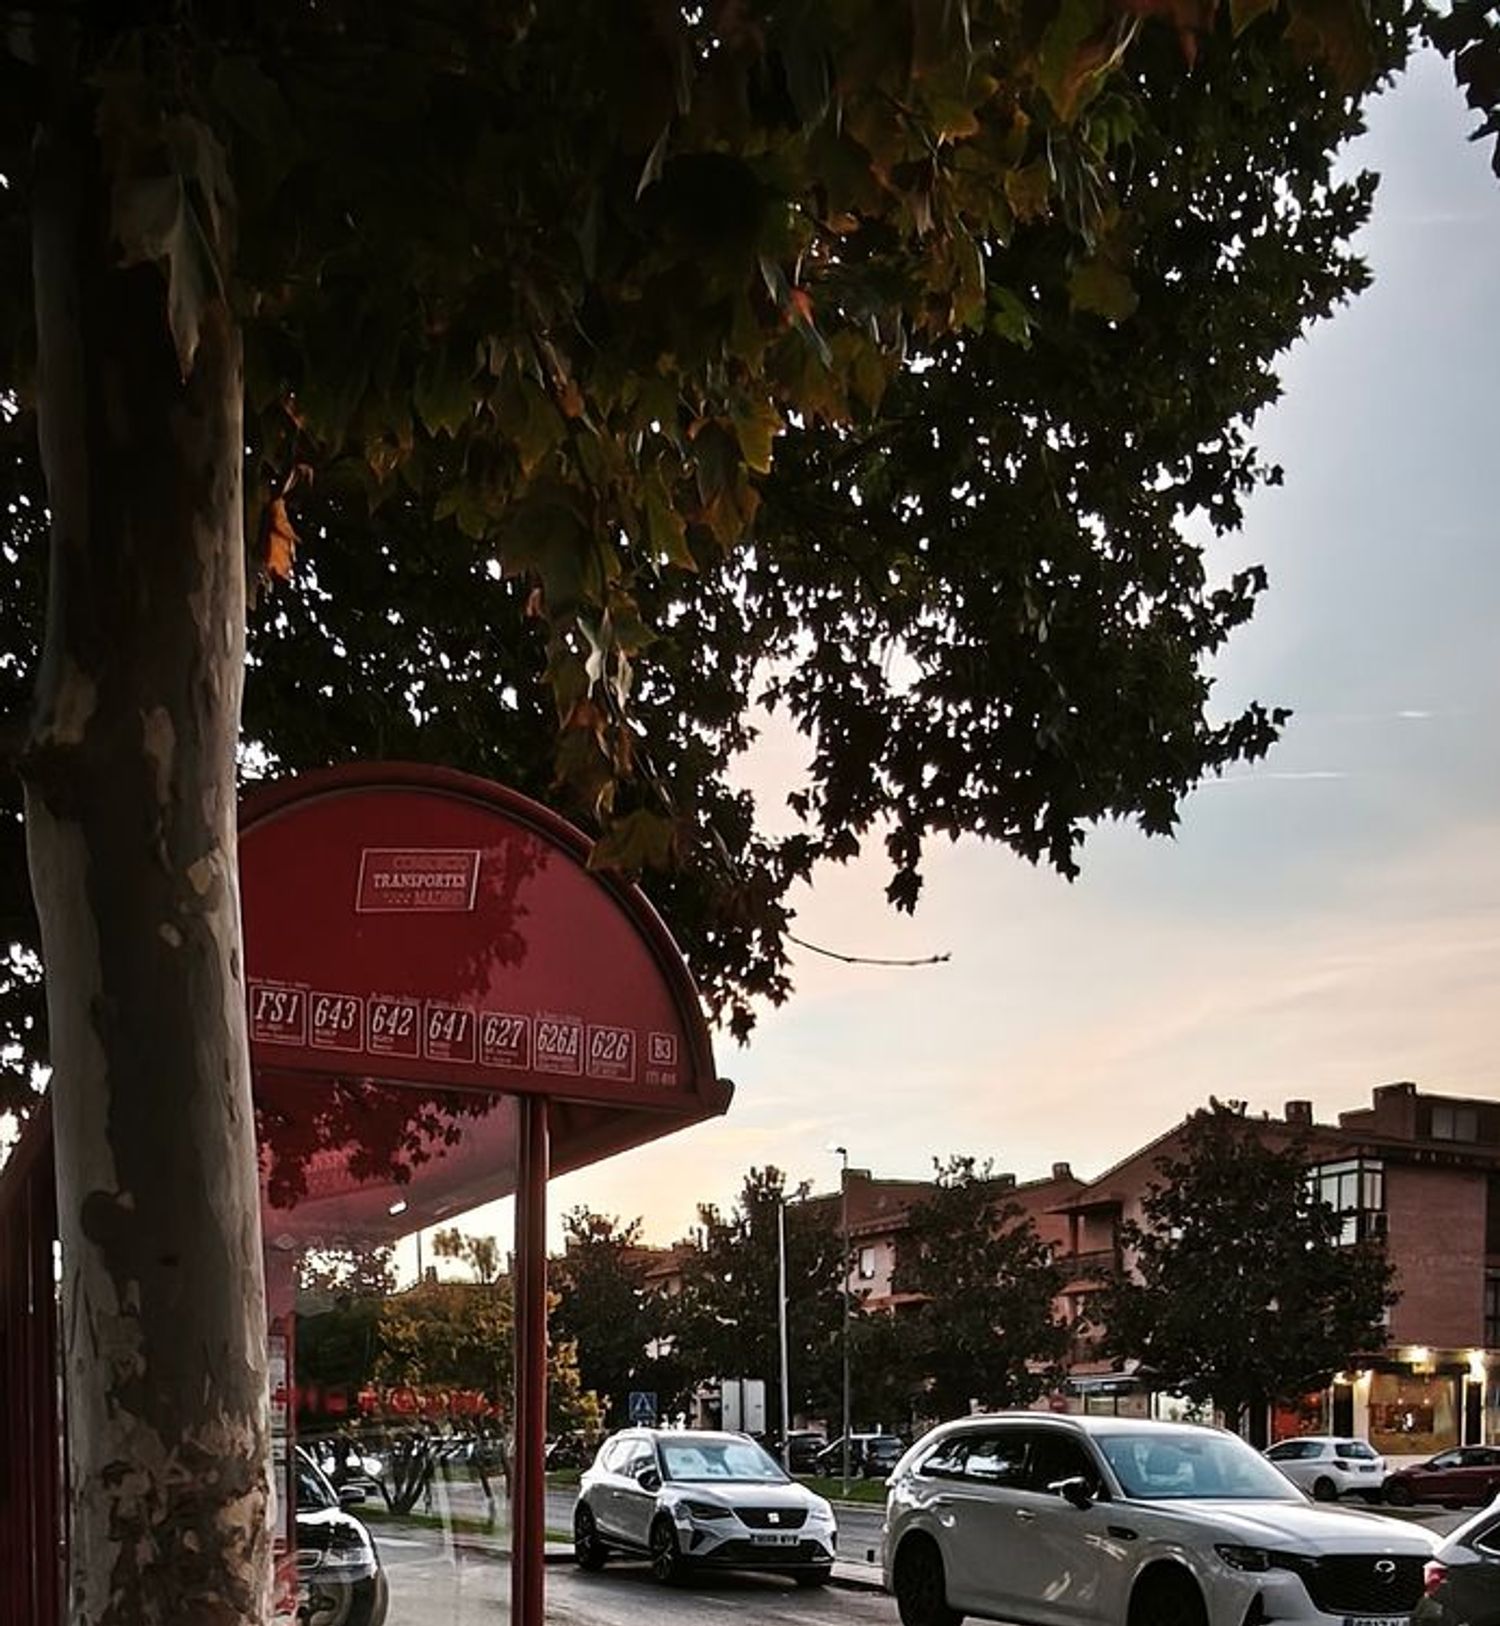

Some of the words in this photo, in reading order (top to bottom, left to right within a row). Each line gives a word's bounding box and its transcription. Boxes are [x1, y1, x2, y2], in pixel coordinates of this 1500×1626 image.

[373, 873, 466, 888] TRANSPORTES
[314, 997, 357, 1030] 643
[372, 1004, 414, 1036] 642
[429, 1010, 467, 1042] 641
[484, 1016, 524, 1048] 627
[537, 1023, 578, 1055] 626A
[591, 1031, 630, 1060] 626
